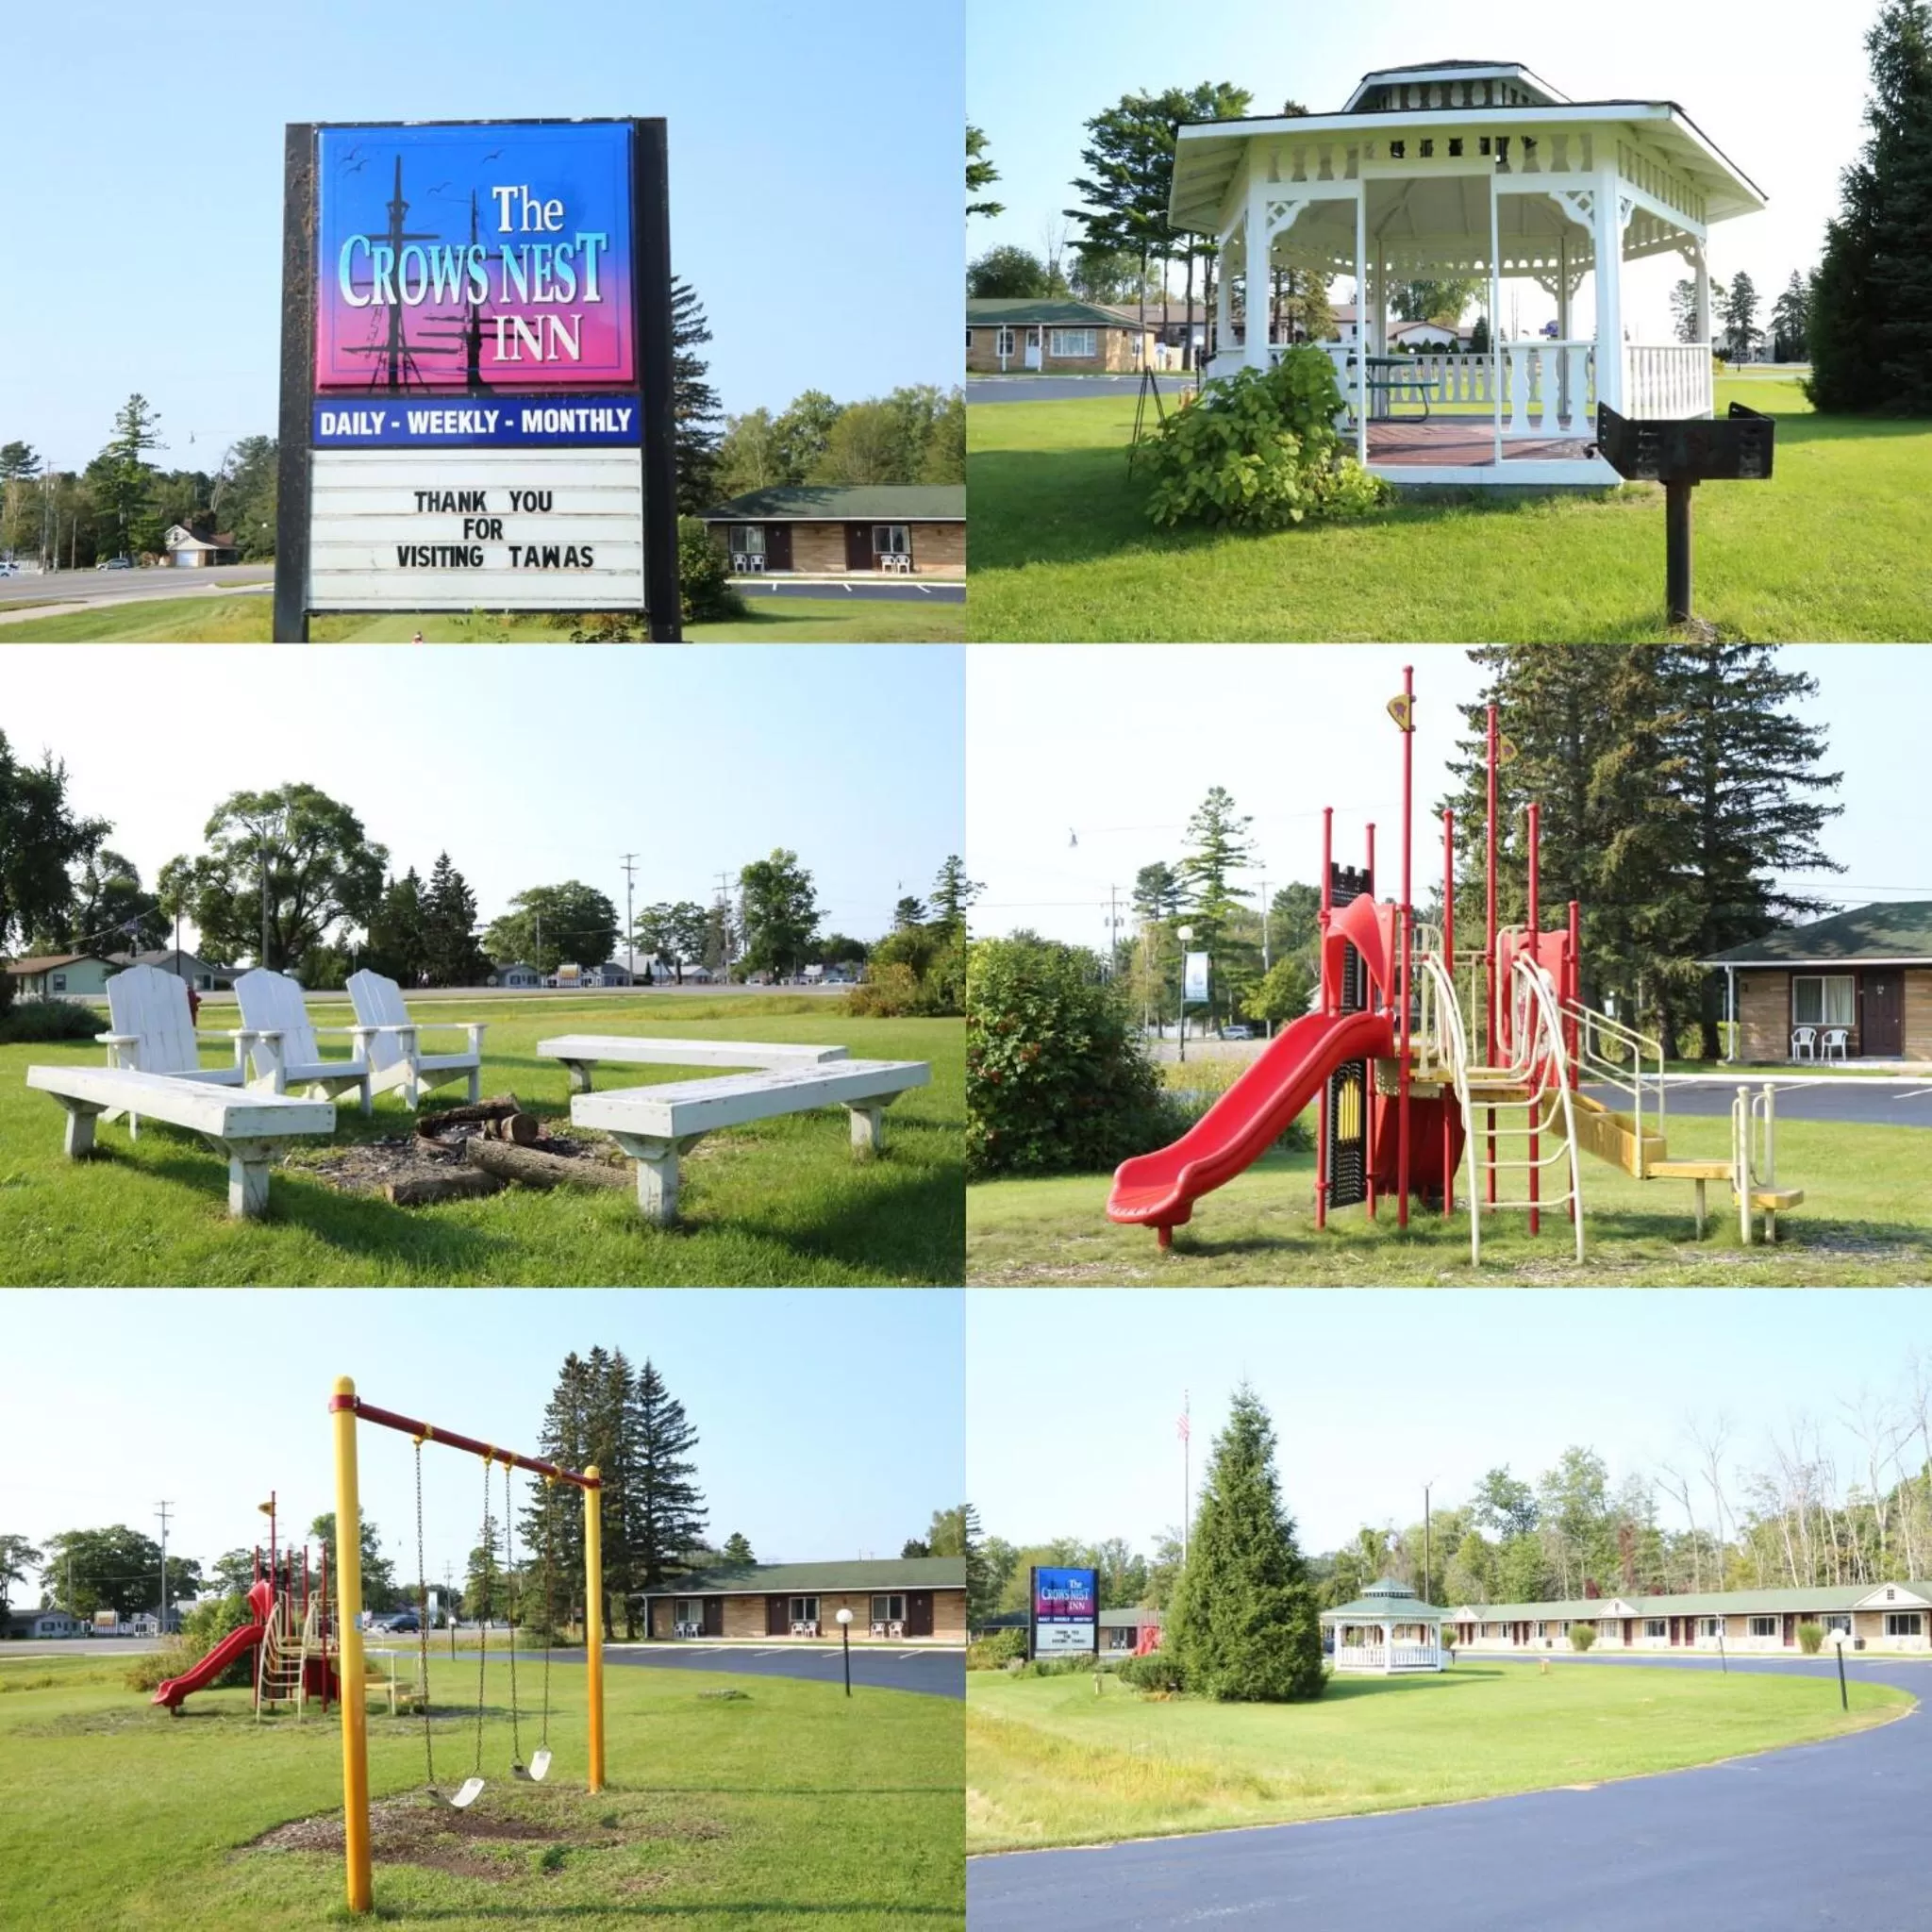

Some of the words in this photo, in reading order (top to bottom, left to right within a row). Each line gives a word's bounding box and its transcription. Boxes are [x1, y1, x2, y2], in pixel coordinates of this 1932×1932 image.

[492, 185, 565, 233] The
[339, 233, 490, 307] CROWS
[499, 231, 608, 305] NEST
[492, 314, 584, 362] INN
[321, 411, 387, 436] DAILY
[408, 409, 499, 435] WEEKLY
[522, 408, 632, 434] MONTHLY
[414, 490, 487, 512] THANK
[509, 490, 553, 512] YOU
[463, 518, 504, 541] FOR
[396, 545, 484, 569] VISITING
[510, 545, 594, 569] TAWAS
[1069, 1602, 1085, 1610] INN
